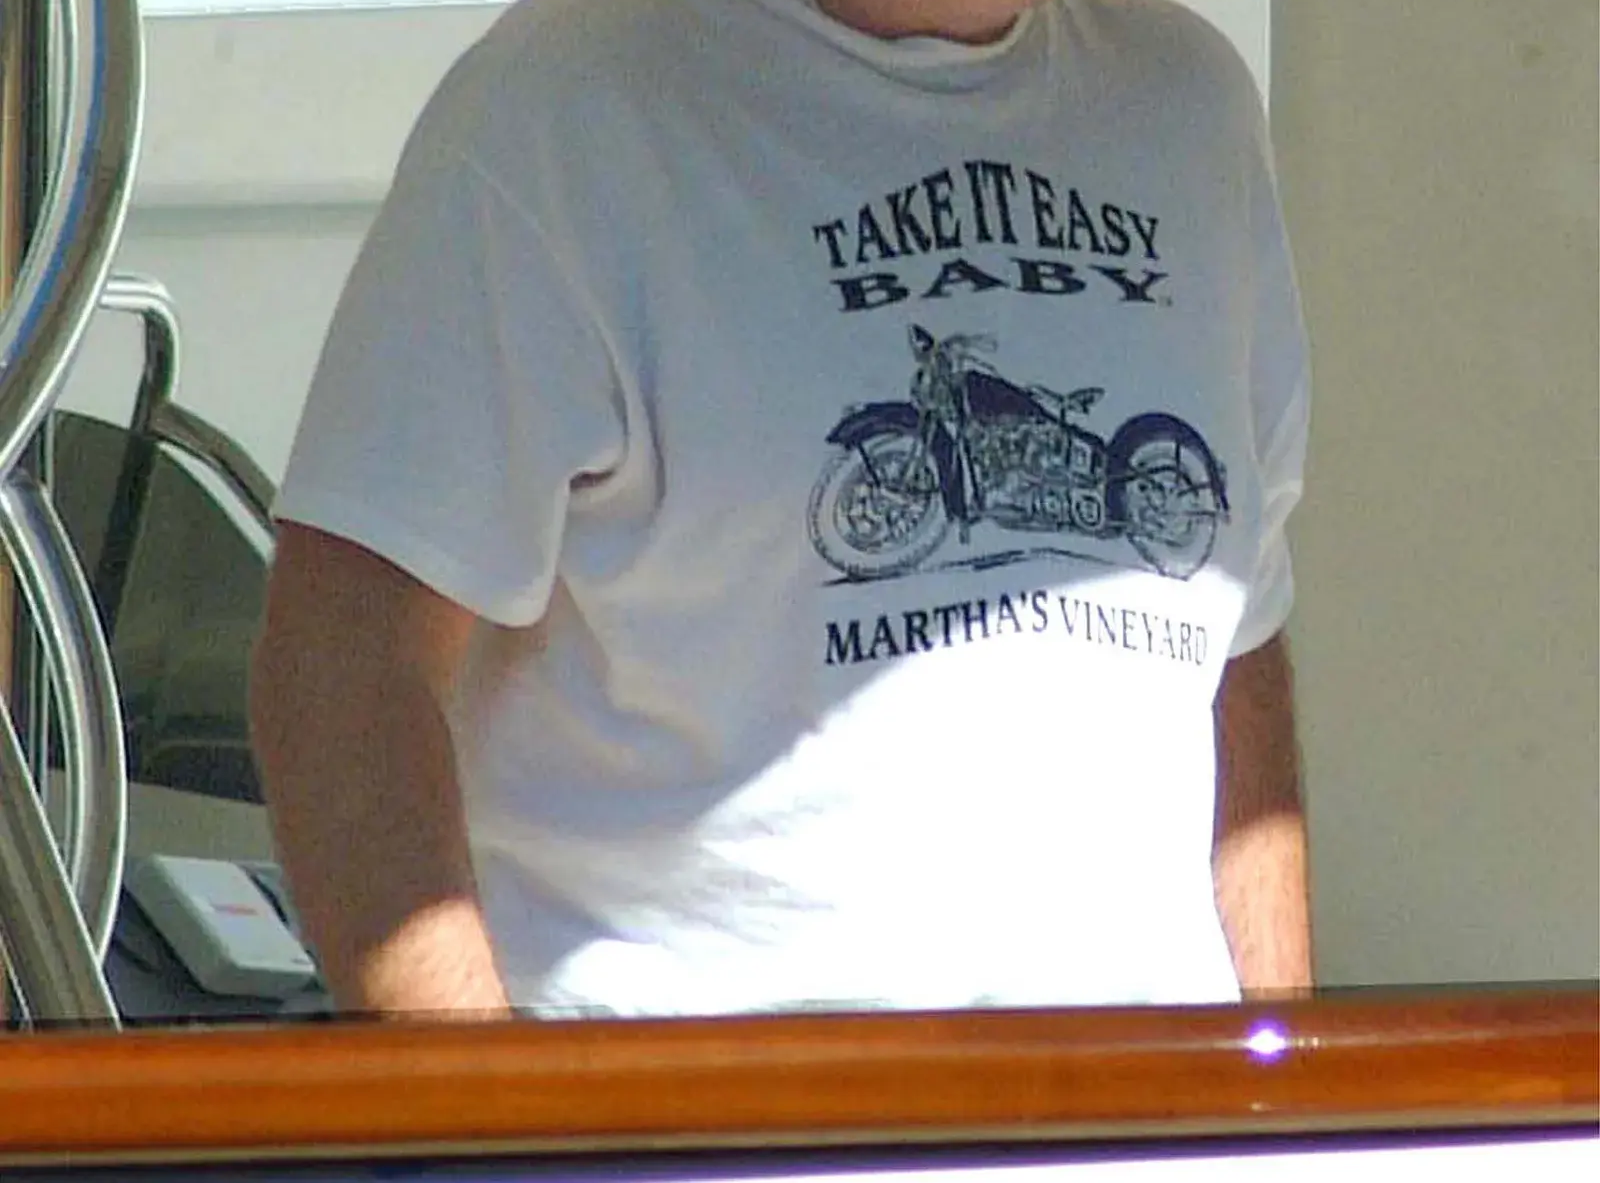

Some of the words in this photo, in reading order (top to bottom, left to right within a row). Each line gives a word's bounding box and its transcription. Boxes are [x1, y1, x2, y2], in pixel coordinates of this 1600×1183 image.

[812, 168, 964, 268] TAKE
[963, 159, 1018, 245] IT
[1024, 168, 1160, 260] EASY
[831, 257, 1169, 311] BABY
[824, 589, 1048, 665] MARTHA'S
[1059, 595, 1208, 666] VINEYARD
